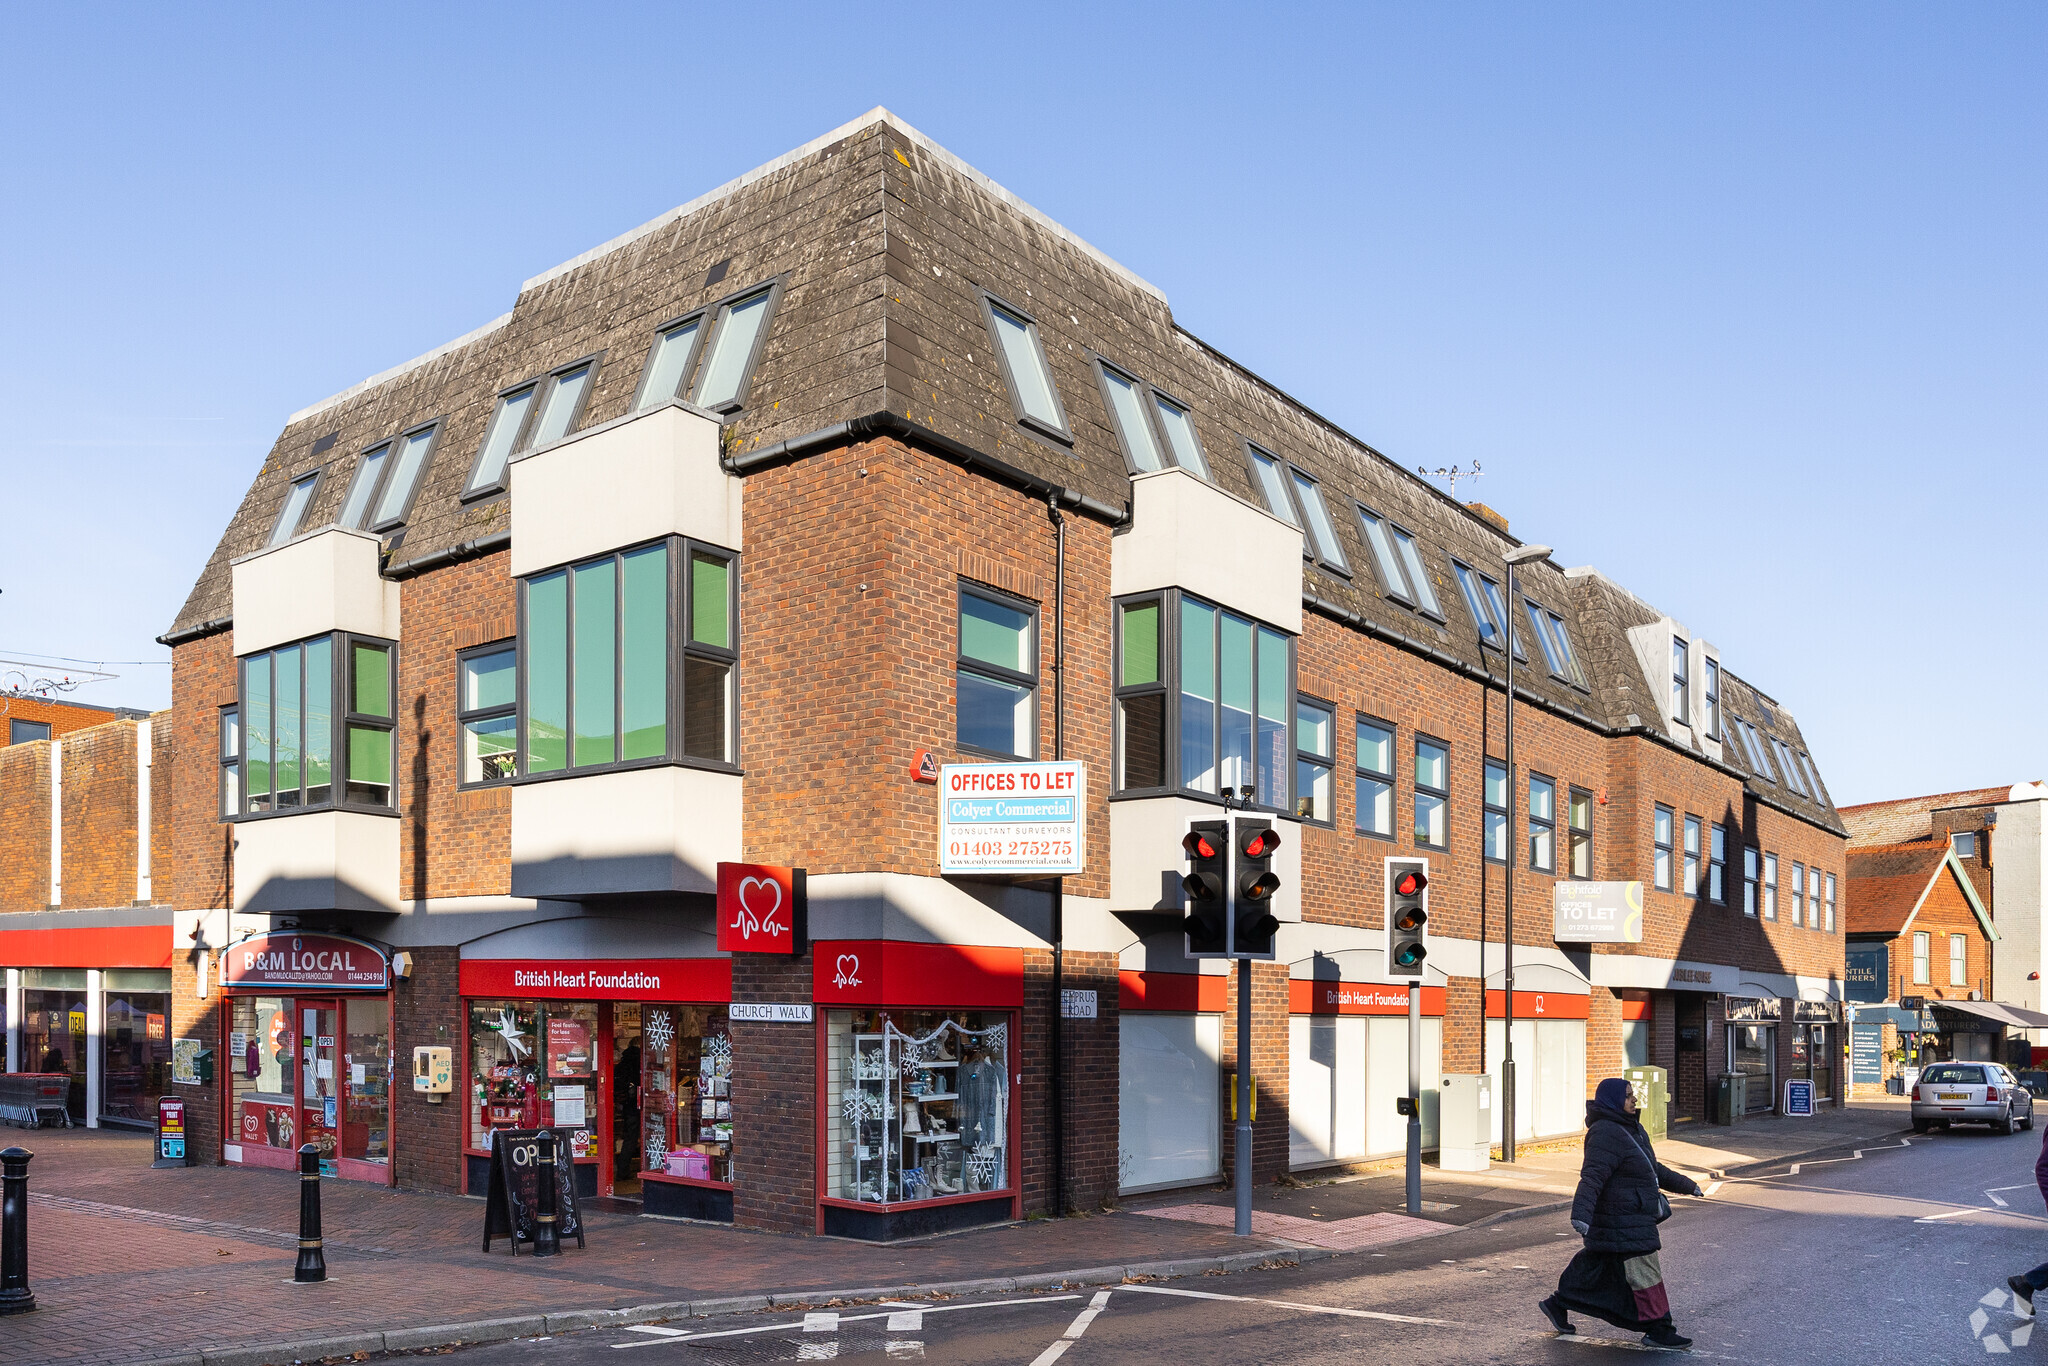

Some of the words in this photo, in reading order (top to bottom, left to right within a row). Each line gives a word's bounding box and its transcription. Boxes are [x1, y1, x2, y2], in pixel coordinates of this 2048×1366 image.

[952, 773, 1015, 791] OFFICES
[1020, 772, 1040, 790] TO
[1046, 772, 1074, 790] LET
[952, 802, 993, 820] Colyer
[996, 800, 1070, 816] Commercial
[950, 842, 1002, 856] 01403
[1008, 841, 1072, 856] 275275
[950, 858, 1072, 866] www.colyercommercial.co.uk
[1560, 908, 1582, 920] TO
[1588, 908, 1617, 920] LET
[244, 952, 284, 970] B&M
[292, 952, 356, 971] LOCAL
[515, 970, 550, 986] British
[553, 971, 586, 987] Heart
[589, 971, 660, 989] Foundation
[1064, 992, 1095, 1002] CYPRUS
[1327, 990, 1352, 1005] British
[1354, 991, 1373, 1005] Heart
[1375, 992, 1409, 1006] Foundatio
[732, 1006, 772, 1019] CHURCH
[779, 1006, 808, 1019] WALK
[1068, 1005, 1091, 1016] ROAD
[149, 1024, 163, 1039] FREE
[320, 1037, 332, 1045] OPEN
[513, 1144, 557, 1166] OP
